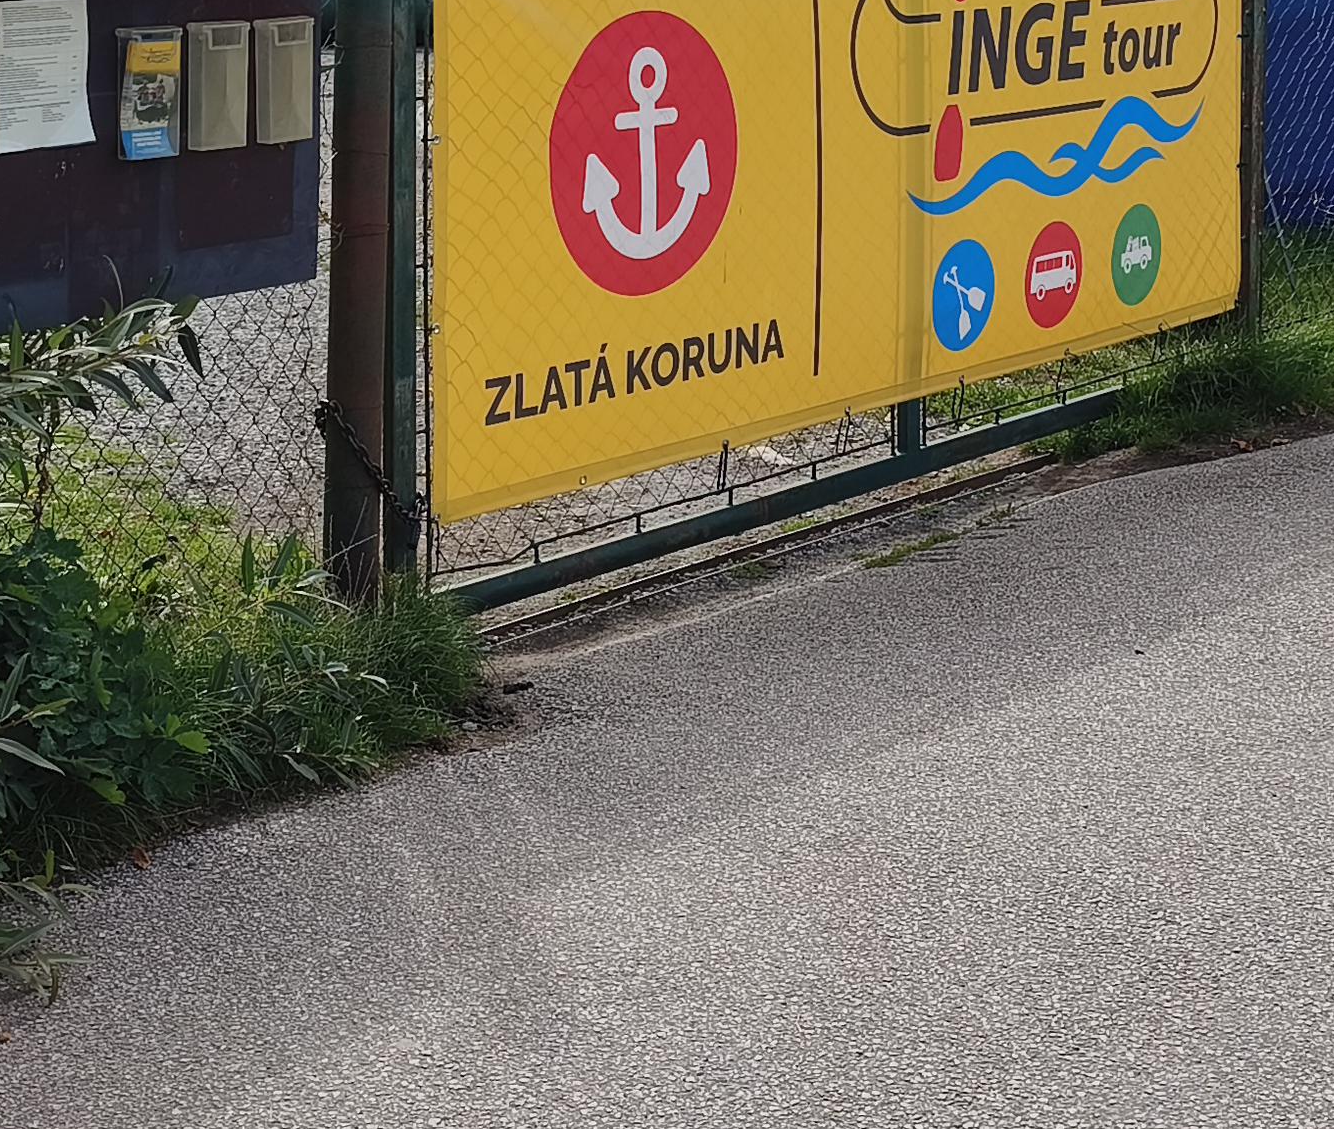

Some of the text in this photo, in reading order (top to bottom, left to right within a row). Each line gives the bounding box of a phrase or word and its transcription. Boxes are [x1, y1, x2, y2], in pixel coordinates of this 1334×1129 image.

[1103, 21, 1182, 75] tour
[485, 318, 785, 426] ZLATÁ KORUNA
